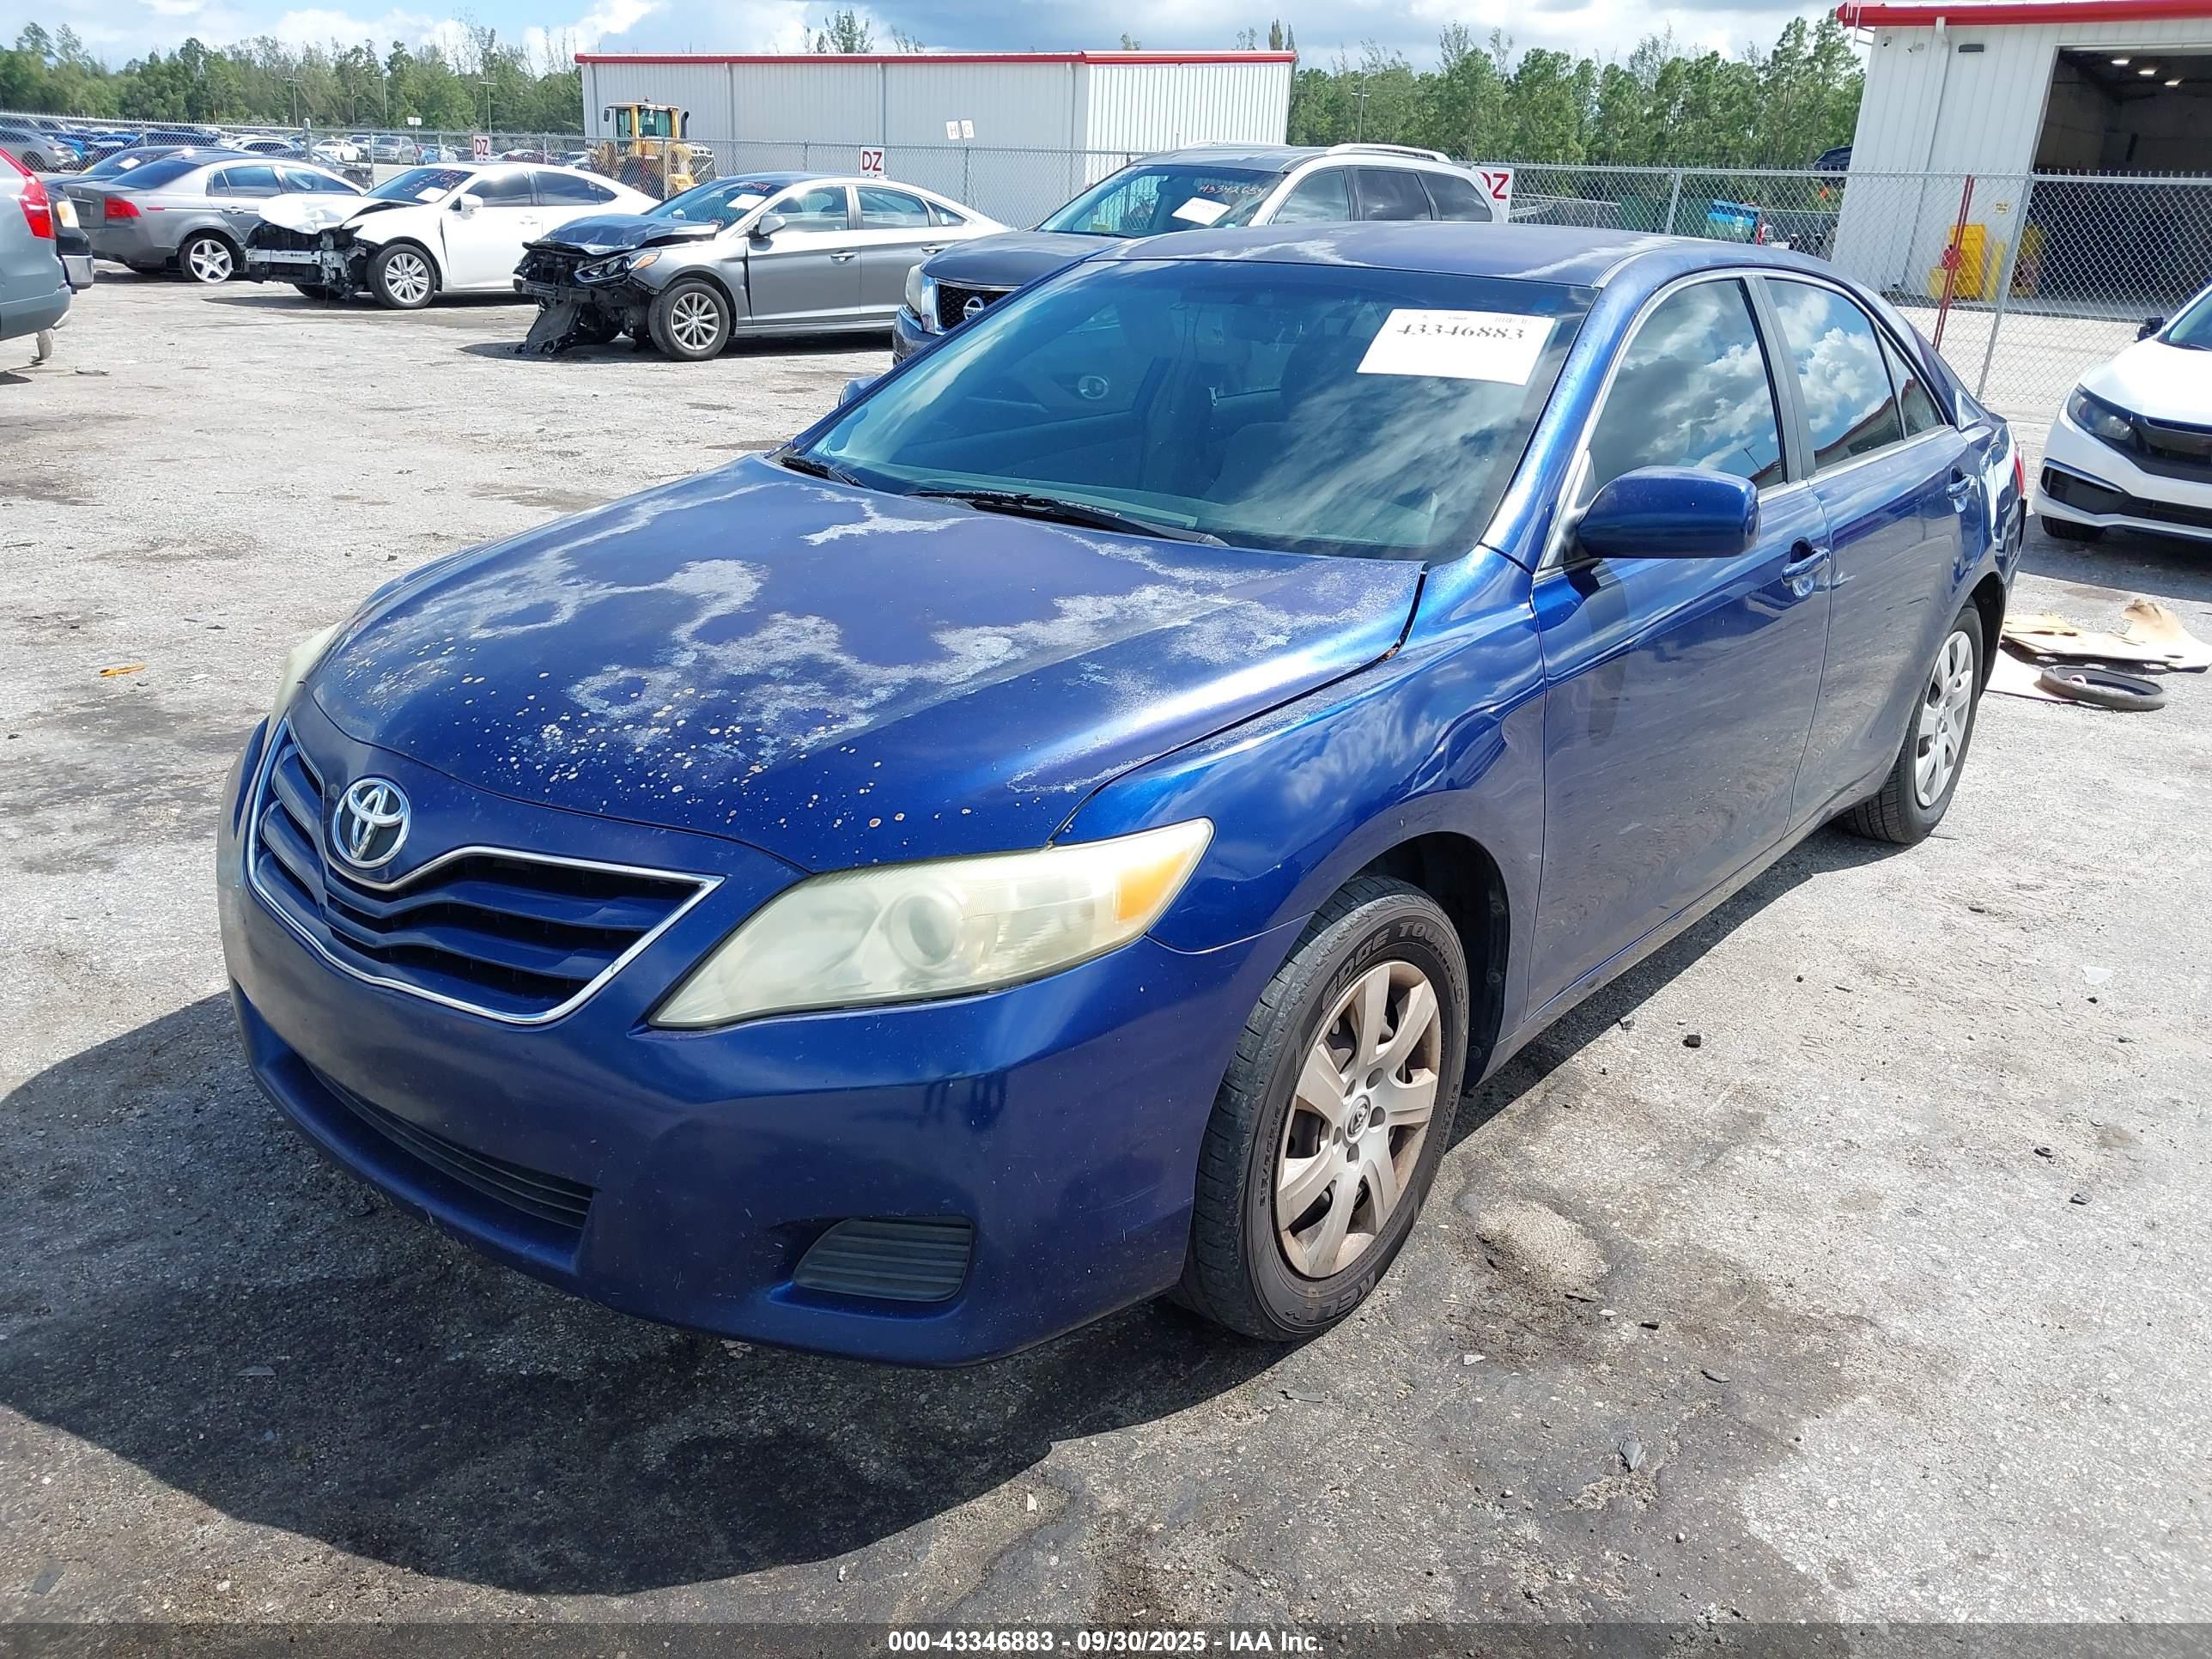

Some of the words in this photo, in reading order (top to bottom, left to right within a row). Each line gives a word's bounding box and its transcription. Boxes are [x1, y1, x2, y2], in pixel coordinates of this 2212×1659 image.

[475, 139, 489, 155] DZ
[862, 151, 882, 171] DZ
[1396, 323, 1525, 340] 43346883
[1321, 927, 1391, 1011] EDGE
